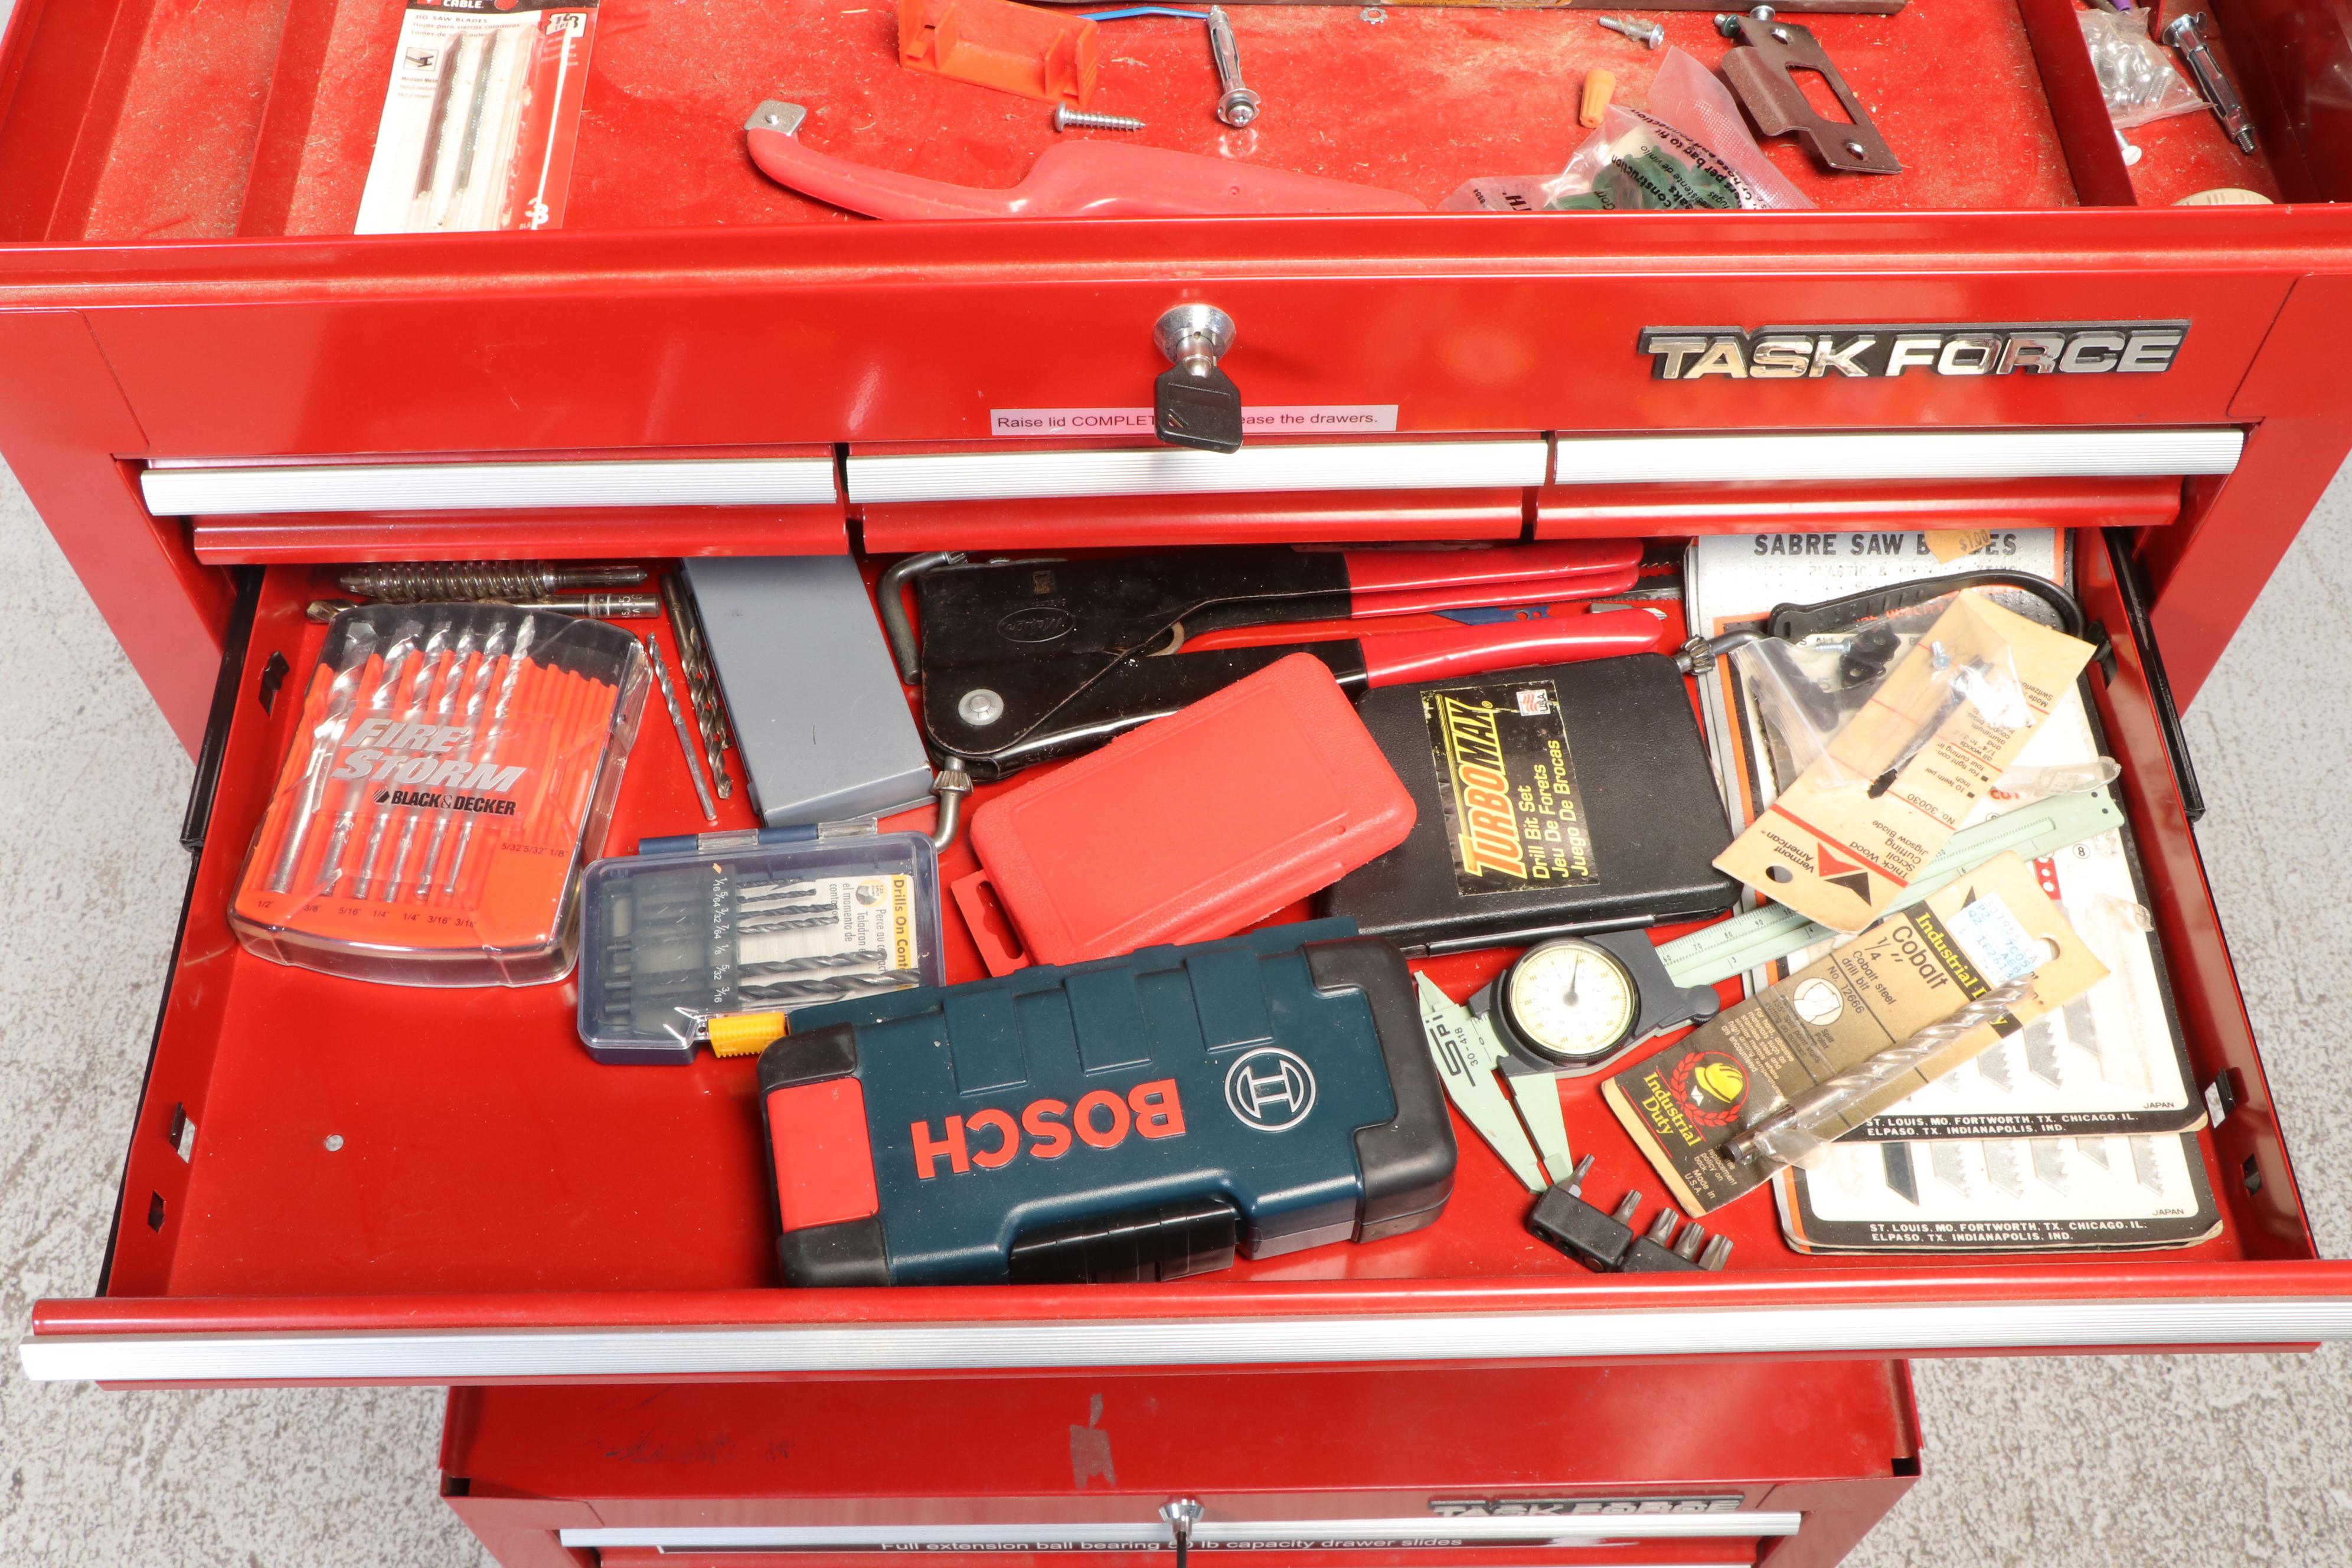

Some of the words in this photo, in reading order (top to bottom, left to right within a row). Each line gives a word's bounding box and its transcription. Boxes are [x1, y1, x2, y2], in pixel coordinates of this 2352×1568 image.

[443, 0, 482, 8] CABLE
[1683, 148, 1706, 169] bag
[1612, 155, 1672, 208] construction
[1704, 164, 1727, 183] per
[1649, 334, 1877, 378] TASK
[1885, 329, 2183, 377] FORCE
[998, 417, 1043, 427] Raise
[1049, 417, 1066, 426] lid
[1072, 416, 1155, 426] COMPLET
[1240, 416, 1275, 424] ease
[1280, 414, 1304, 424] the
[1311, 414, 1377, 424] drawers.
[1754, 534, 1837, 556] SABRE
[1850, 534, 1903, 556] SAW
[1917, 534, 2017, 556] BES
[1959, 529, 1989, 551] $1.00
[2028, 695, 2048, 707] Made
[342, 717, 470, 752] FIRE
[1986, 740, 2001, 750] and
[1944, 746, 1969, 765] cutting
[1960, 741, 1982, 756] woods
[331, 749, 527, 792] STORM
[1550, 740, 1570, 795] Brocas
[1925, 767, 1937, 776] per
[1968, 767, 1979, 776] For
[1534, 765, 1556, 815] Forets
[1955, 784, 1964, 793] 10
[1956, 776, 1971, 788] inch
[391, 790, 516, 815] BLACK&DECKER
[1518, 785, 1533, 812] Set
[1907, 793, 1938, 814] 30030
[1559, 801, 1576, 821] De
[1942, 812, 1955, 825] No.
[1523, 818, 1541, 839] Bit
[1544, 821, 1562, 841] De
[1872, 819, 1896, 837] Blade
[1567, 827, 1589, 876] Juego
[1766, 831, 1814, 861] American
[1849, 841, 1879, 863] Wood
[1885, 838, 1921, 864] Cutting
[1898, 835, 1928, 856] Jigsaw
[1528, 844, 1550, 878] Drill
[1552, 849, 1569, 877] Jeu
[1774, 845, 1814, 873] Vermont
[1882, 858, 1908, 879] Thick
[1885, 851, 1915, 872] Scroll
[713, 877, 727, 891] 1/16
[713, 891, 728, 907] 5/64
[894, 880, 906, 912] Drills
[714, 908, 729, 923] 3/32
[843, 893, 853, 930] momento
[876, 909, 886, 930] Perce
[1976, 904, 1990, 919] P2
[714, 925, 729, 939] 7/64
[857, 911, 869, 946] Taladran
[896, 916, 907, 935] On
[877, 933, 884, 942] au
[714, 944, 729, 955] 1/8
[1893, 926, 1948, 989] Cobalt
[1916, 912, 1978, 988] Industrial
[714, 965, 730, 980] 5/32
[1842, 958, 1859, 976] drill
[1856, 977, 1870, 991] bit
[1853, 950, 1879, 981] Cobalt
[1875, 983, 1897, 1005] steel
[714, 986, 730, 1003] 3/16
[1828, 966, 1840, 982] No.
[1840, 985, 1864, 1014] 12666
[1728, 1020, 1740, 1035] high
[1739, 1036, 1756, 1057] drilling
[1740, 1015, 1761, 1041] stainless
[1759, 1041, 1773, 1056] steel
[1770, 1057, 1782, 1070] and
[1747, 1011, 1769, 1039] materials
[1767, 1040, 1781, 1055] such
[1779, 1056, 1786, 1064] as
[1754, 1007, 1764, 1018] For
[1775, 1037, 1794, 1062] abrasive
[1794, 1030, 1808, 1045] point
[1815, 1033, 1829, 1049] Point
[1821, 1029, 1834, 1043] Split
[1721, 1025, 1731, 1035] are
[1729, 1036, 1758, 1074] encountered.
[1734, 1018, 1751, 1038] similar
[1749, 1040, 1766, 1060] metals
[1765, 1061, 1779, 1080] where
[1642, 1096, 1674, 1134] Duty
[1644, 1072, 1702, 1147] Industrial
[2143, 1100, 2175, 1109] JAPAN
[910, 1079, 1187, 1180] BOSCH
[1866, 1119, 1884, 1127] ST.
[1694, 1156, 1707, 1174] back.
[1700, 1152, 1716, 1171] policy
[1715, 1172, 1723, 1182] on
[1708, 1148, 1737, 1185] replacement
[1684, 1173, 1702, 1195] U.S.A.
[1693, 1169, 1709, 1190] Made
[1707, 1190, 1716, 1199] in
[2152, 1208, 2185, 1216] JAPAN
[1433, 1504, 1564, 1517] TASK
[1570, 1500, 1741, 1515] FORCE
[881, 1542, 919, 1550] Full
[926, 1541, 1028, 1550] extension
[1036, 1541, 1073, 1550] ball
[1080, 1541, 1160, 1551] bearing
[1201, 1540, 1219, 1549] lb
[1226, 1539, 1314, 1550] capacity
[1321, 1538, 1396, 1548] drawer
[1402, 1538, 1462, 1547] slides
